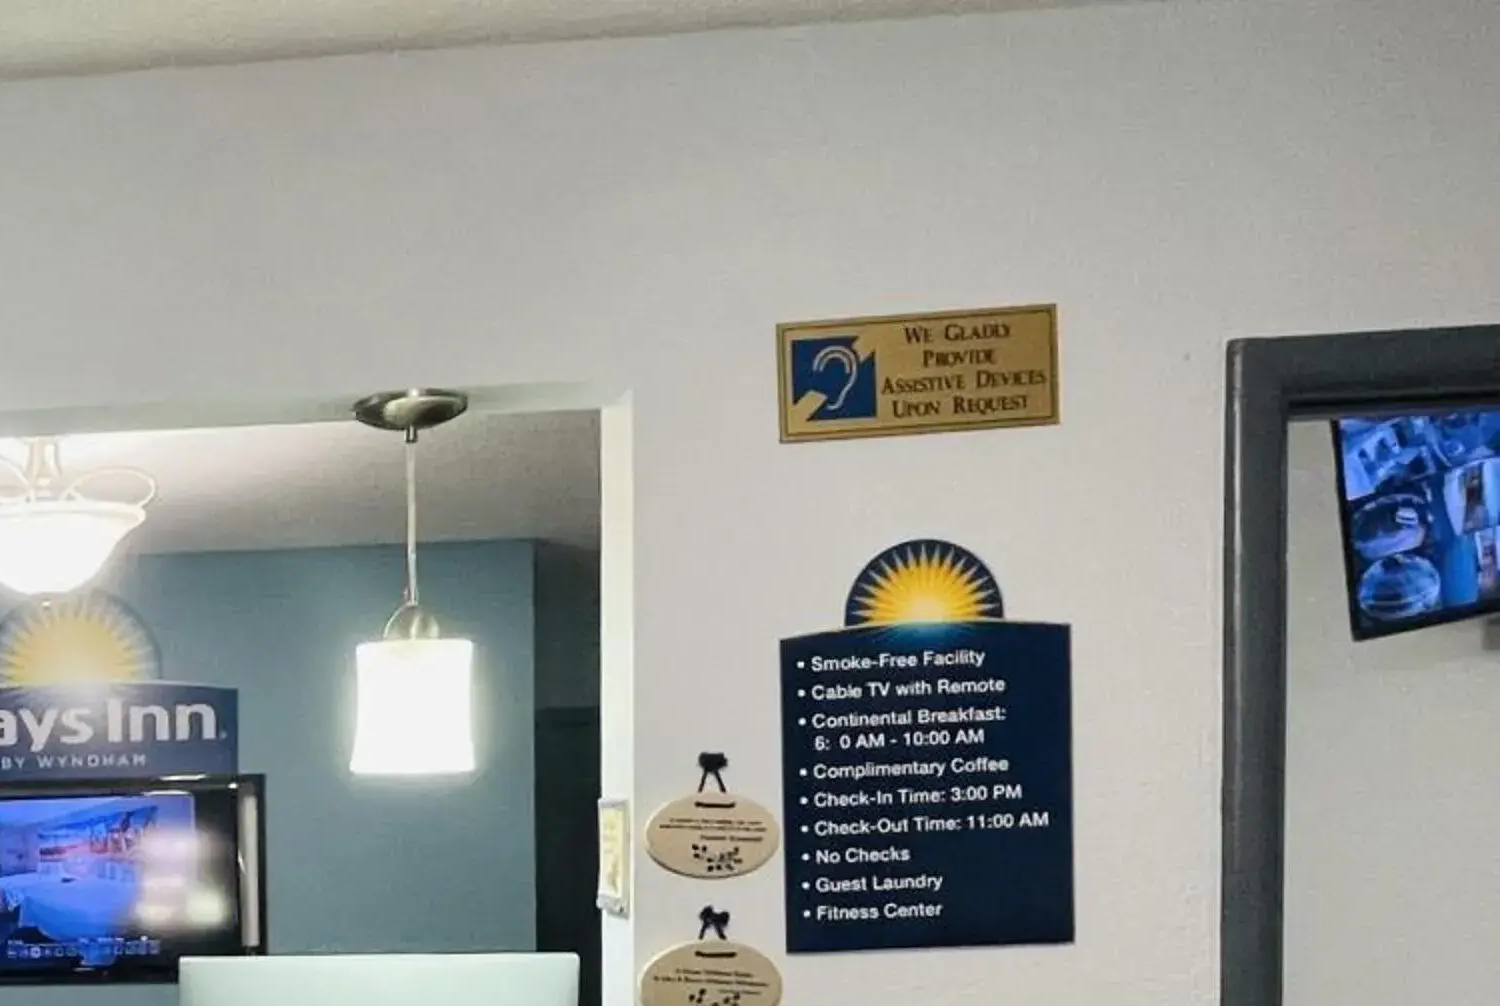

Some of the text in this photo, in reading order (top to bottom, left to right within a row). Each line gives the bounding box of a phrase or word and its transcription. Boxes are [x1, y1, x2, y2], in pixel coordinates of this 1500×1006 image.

[944, 322, 1011, 341] GLADLY
[922, 347, 996, 367] PROVIDE
[880, 368, 1048, 395] ASSISTIVE DEVICES
[892, 395, 1028, 418] UPON REQUEST
[811, 649, 986, 671] Smoke-Free Facility
[811, 676, 1006, 701] Cable TV with Remote
[107, 698, 217, 743] Inn
[812, 706, 1007, 729] Continental Breakfast:
[856, 732, 885, 748] AM
[903, 731, 951, 747] 10:00
[955, 728, 985, 744] AM
[0, 754, 148, 770] BY WYNDHAM
[813, 758, 1010, 783] Complimentary Coffee
[814, 784, 1024, 808] Check-In Time: 3:00 PM
[814, 811, 1050, 836] Check-Out Time: 11:00 AM
[815, 845, 912, 864] No Checks
[815, 873, 944, 893] Guest Laundry
[816, 901, 944, 921] Fitness Center
